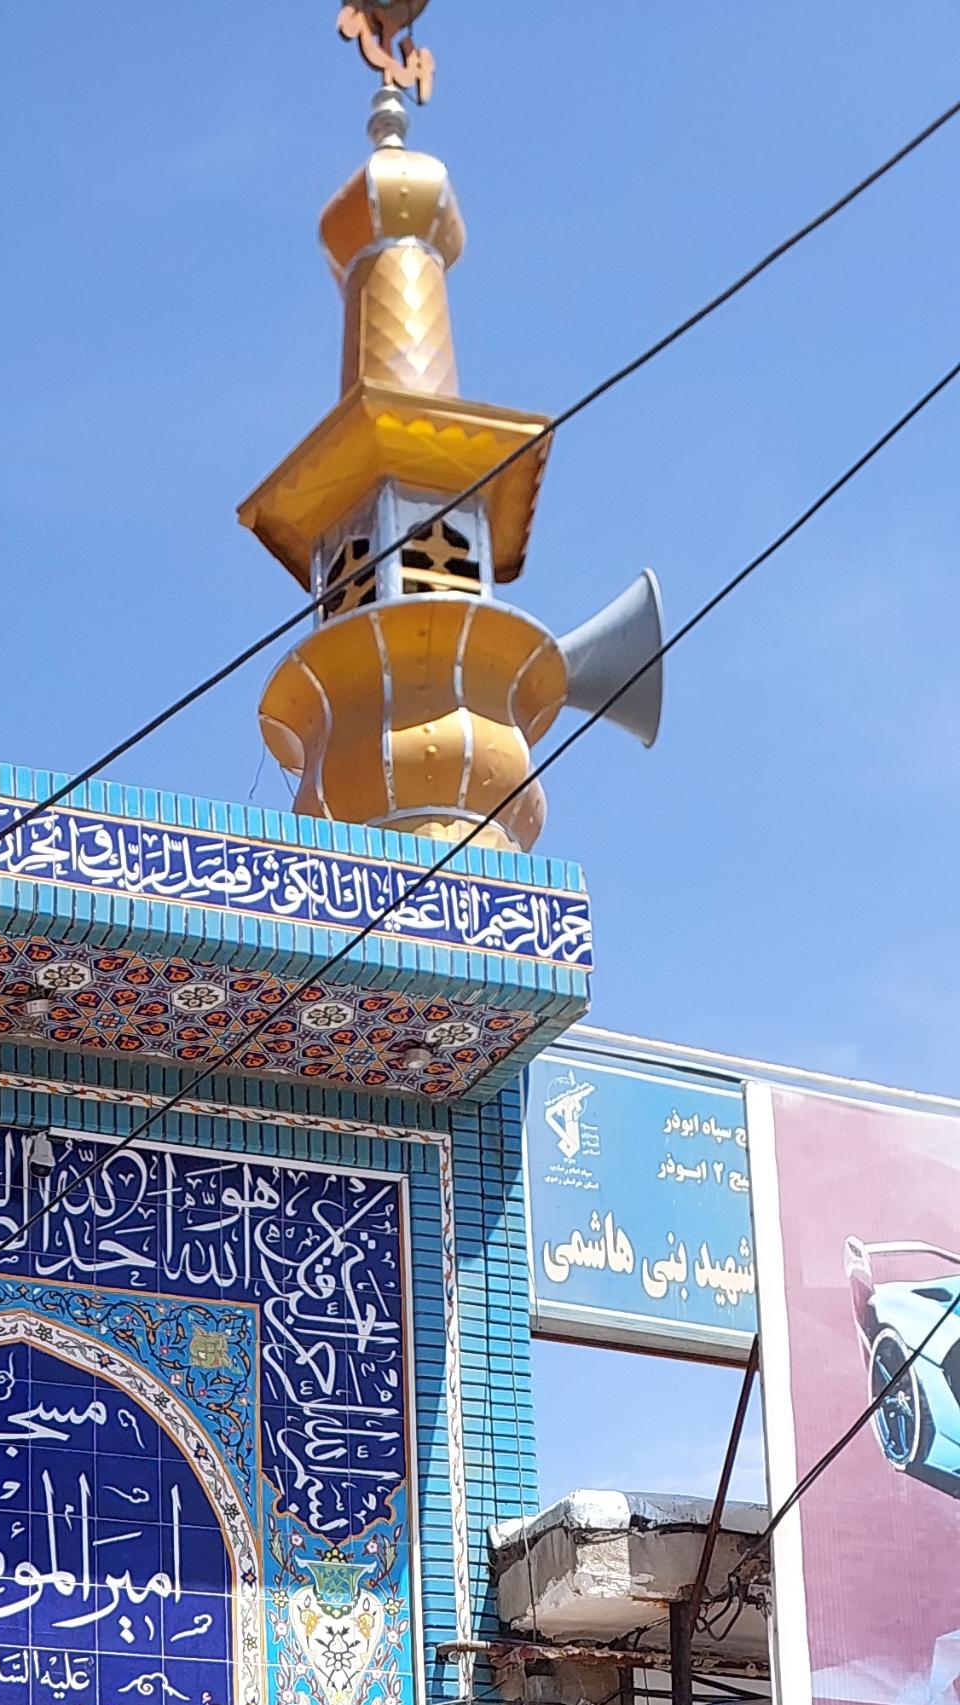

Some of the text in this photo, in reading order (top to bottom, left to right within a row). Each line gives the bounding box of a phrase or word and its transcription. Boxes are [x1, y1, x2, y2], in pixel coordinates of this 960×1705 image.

[663, 1108, 700, 1137] ابوذر
[702, 1117, 732, 1144] سپاه
[543, 1209, 635, 1284] هاشمی
[642, 1231, 689, 1301] بنی
